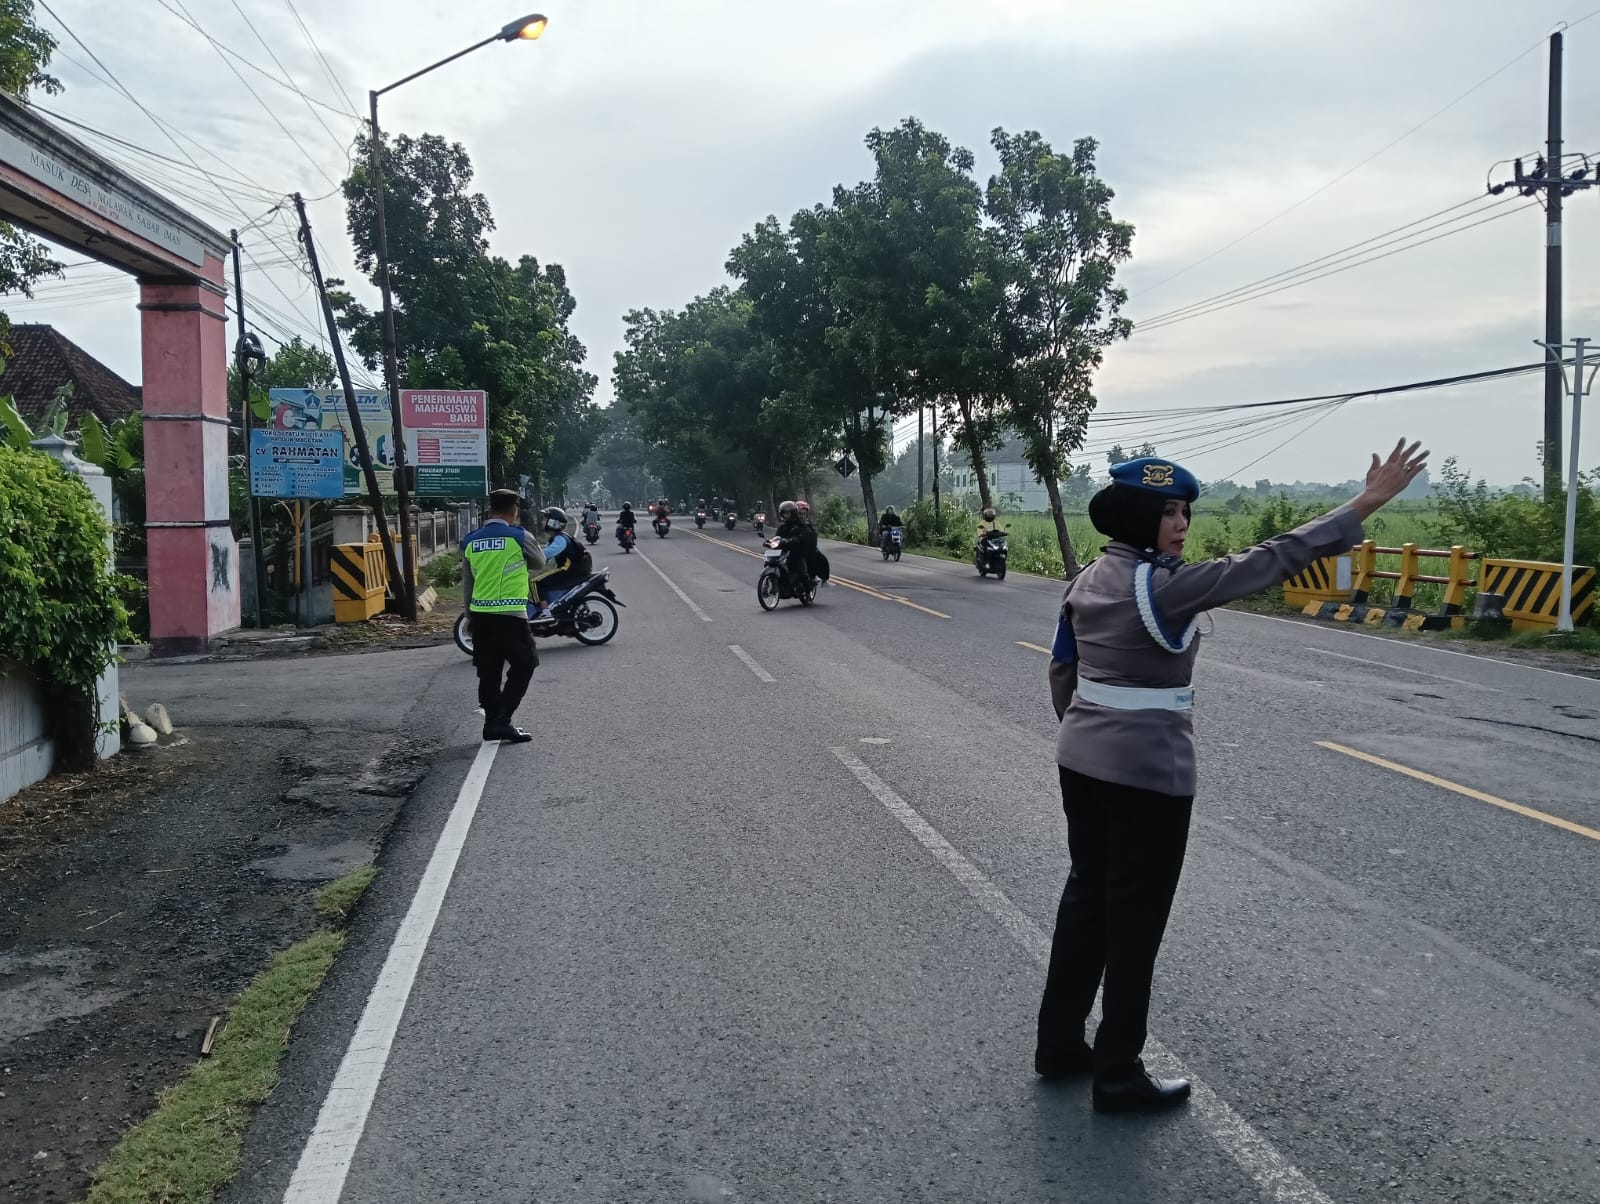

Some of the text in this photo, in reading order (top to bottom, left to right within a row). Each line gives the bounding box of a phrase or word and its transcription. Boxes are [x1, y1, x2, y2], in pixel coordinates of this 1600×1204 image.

[30, 151, 65, 182] MASUK
[97, 190, 134, 221] NGLAWAK
[324, 395, 378, 404] STIM
[411, 394, 477, 404] PENERIMAAN
[415, 404, 477, 414] MAHASISWA
[450, 413, 477, 423] BARU
[272, 446, 338, 458] RAHMATAN
[473, 539, 505, 552] POLISI
